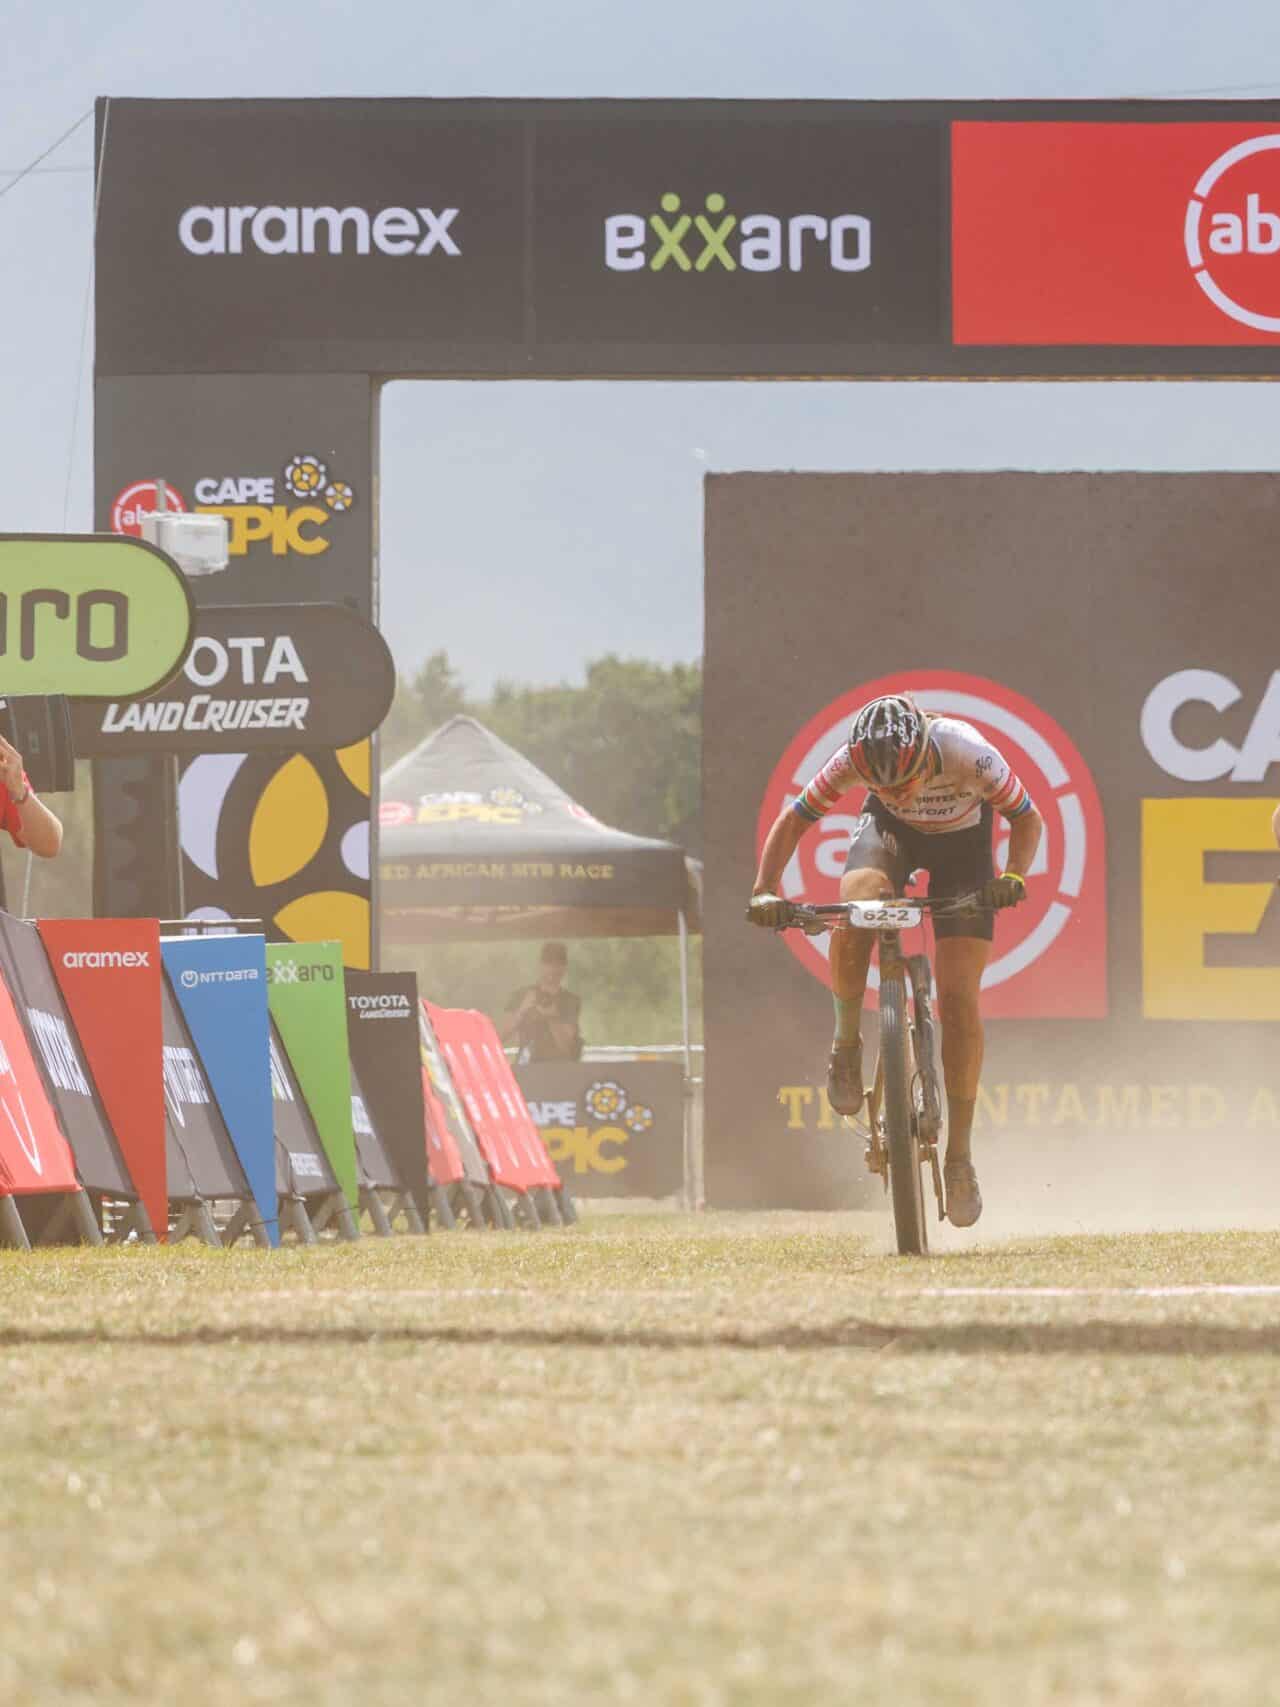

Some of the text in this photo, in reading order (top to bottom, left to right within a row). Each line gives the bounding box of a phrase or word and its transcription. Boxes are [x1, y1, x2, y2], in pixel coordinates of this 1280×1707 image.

[179, 206, 461, 256] aramex
[605, 193, 871, 272] exxaro
[195, 477, 274, 504] CAPE
[0, 588, 129, 662] ro
[184, 636, 309, 686] OTA
[379, 863, 411, 881] ED
[511, 863, 555, 879] MTB
[560, 863, 616, 880] RACE
[863, 909, 910, 922] 62-2
[63, 950, 149, 968] aramex
[348, 994, 411, 1009] TOYOTA
[526, 1101, 577, 1128] APE
[970, 1083, 1229, 1129] NTAMED
[541, 1126, 629, 1174] PIC
